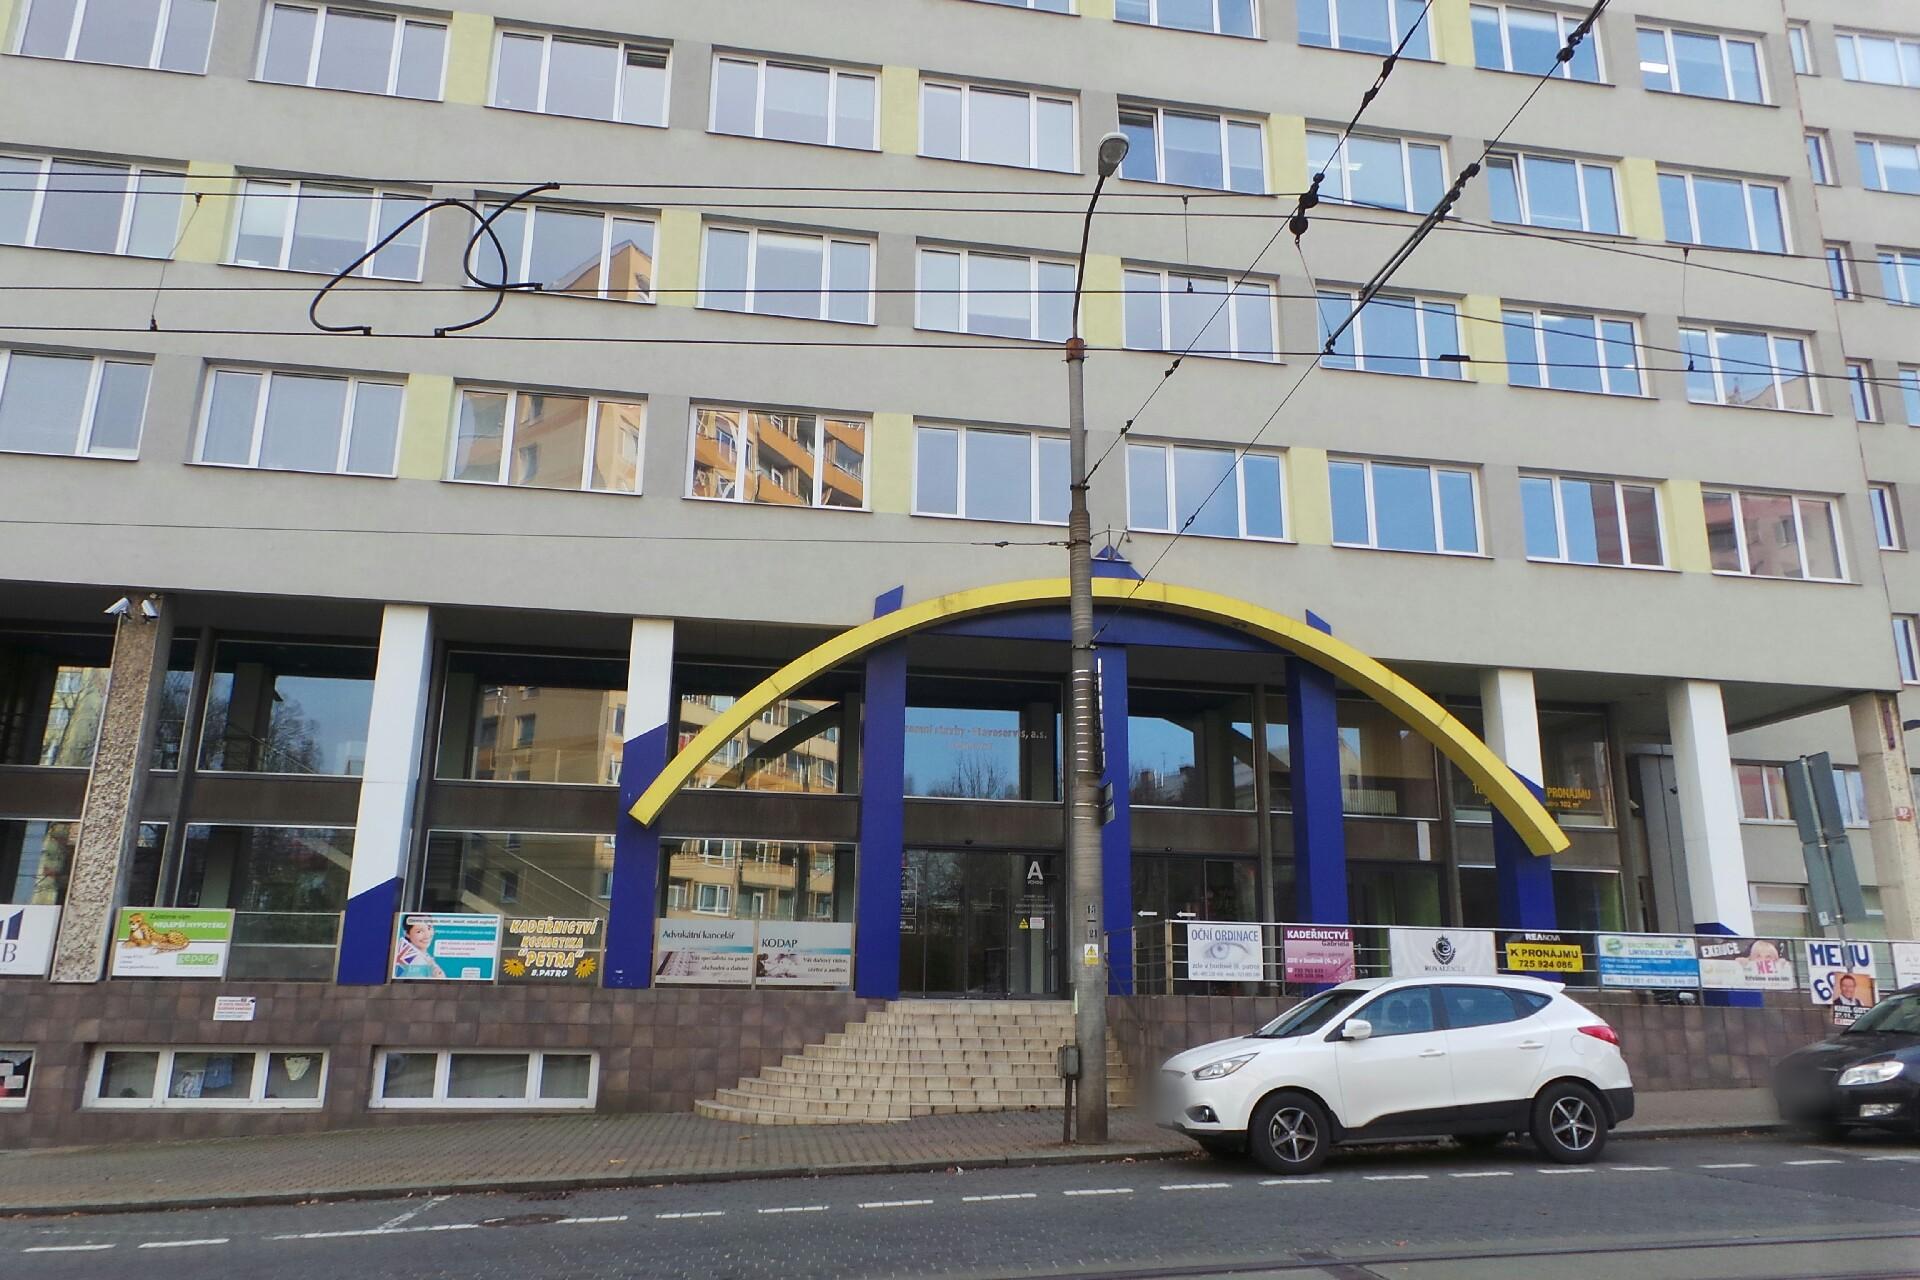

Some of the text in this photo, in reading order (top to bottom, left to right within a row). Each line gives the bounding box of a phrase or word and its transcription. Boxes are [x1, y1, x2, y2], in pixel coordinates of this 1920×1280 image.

[1030, 730, 1048, 739] a.s.
[1026, 861, 1044, 880] A
[509, 916, 600, 935] KADEŘNICTVÍ
[662, 929, 736, 940] Advokátní kancelář
[1191, 927, 1260, 943] OČNÍ ORDINACE
[1286, 928, 1350, 941] KADEŘNICTVÍ
[520, 935, 584, 949] KOSMETIKA
[761, 937, 799, 949] KODAP
[1509, 948, 1579, 959] K PRONÁJMU
[1519, 959, 1536, 968] 725
